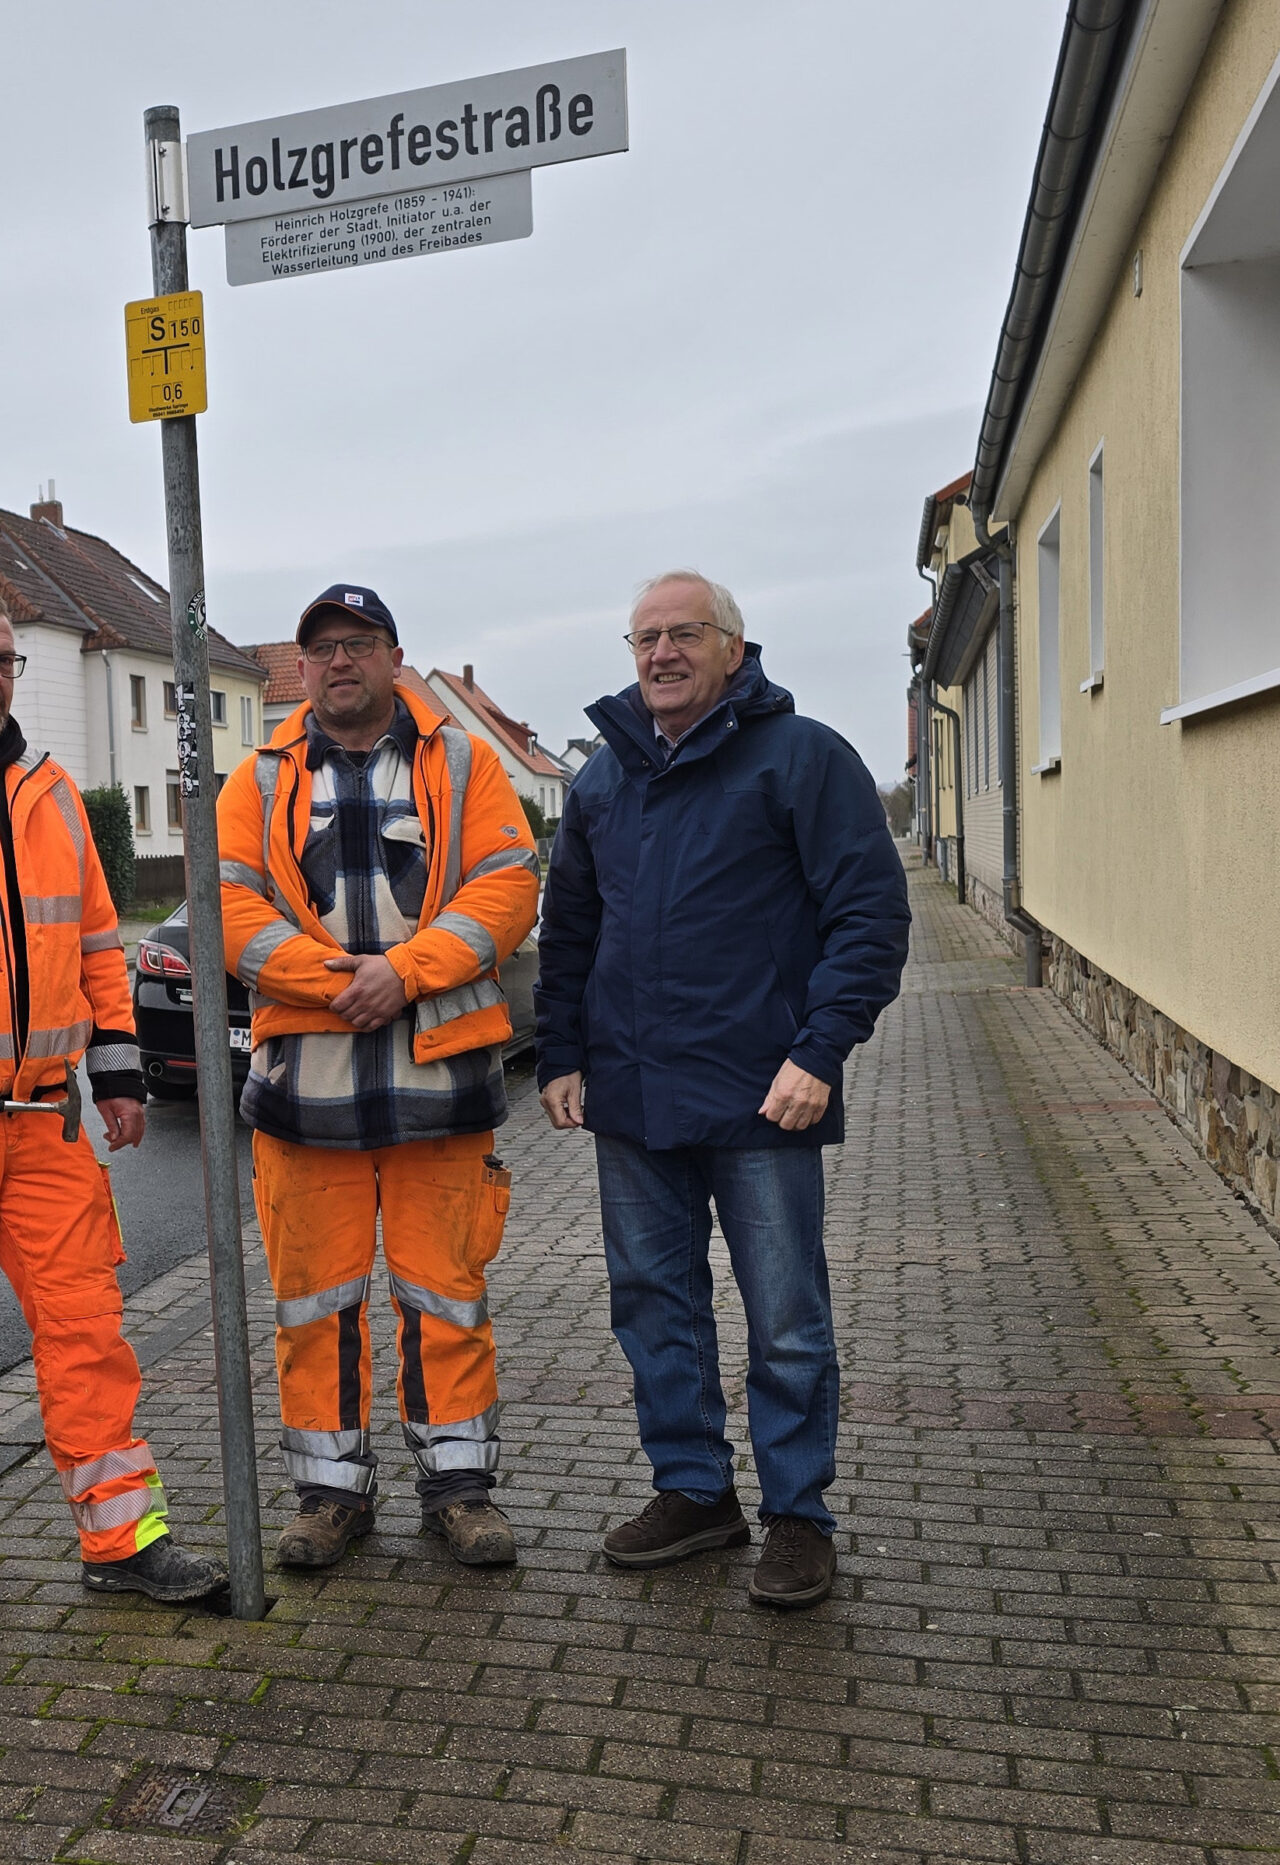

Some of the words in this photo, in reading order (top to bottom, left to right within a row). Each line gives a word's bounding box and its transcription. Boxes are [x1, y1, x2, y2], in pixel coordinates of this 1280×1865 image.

[215, 84, 594, 201] Holzgrefestraße
[260, 232, 313, 248] Förderer
[320, 227, 340, 239] der
[387, 210, 436, 227] Initiator
[442, 206, 464, 217] u.a.
[469, 200, 491, 213] der
[275, 214, 324, 232] Heinrich
[330, 202, 389, 222] Holzgrefe
[394, 195, 425, 211] (1859
[443, 185, 475, 202] 1941):
[262, 239, 355, 263] Elektrifizierung
[404, 227, 424, 239] der
[431, 216, 492, 234] zentralen
[271, 253, 358, 275] Wasserleitung
[363, 246, 386, 260] und
[392, 244, 414, 256] des
[419, 232, 483, 251] Freibades
[150, 316, 166, 341] S
[171, 319, 199, 338] 150
[163, 383, 183, 403] 0,6
